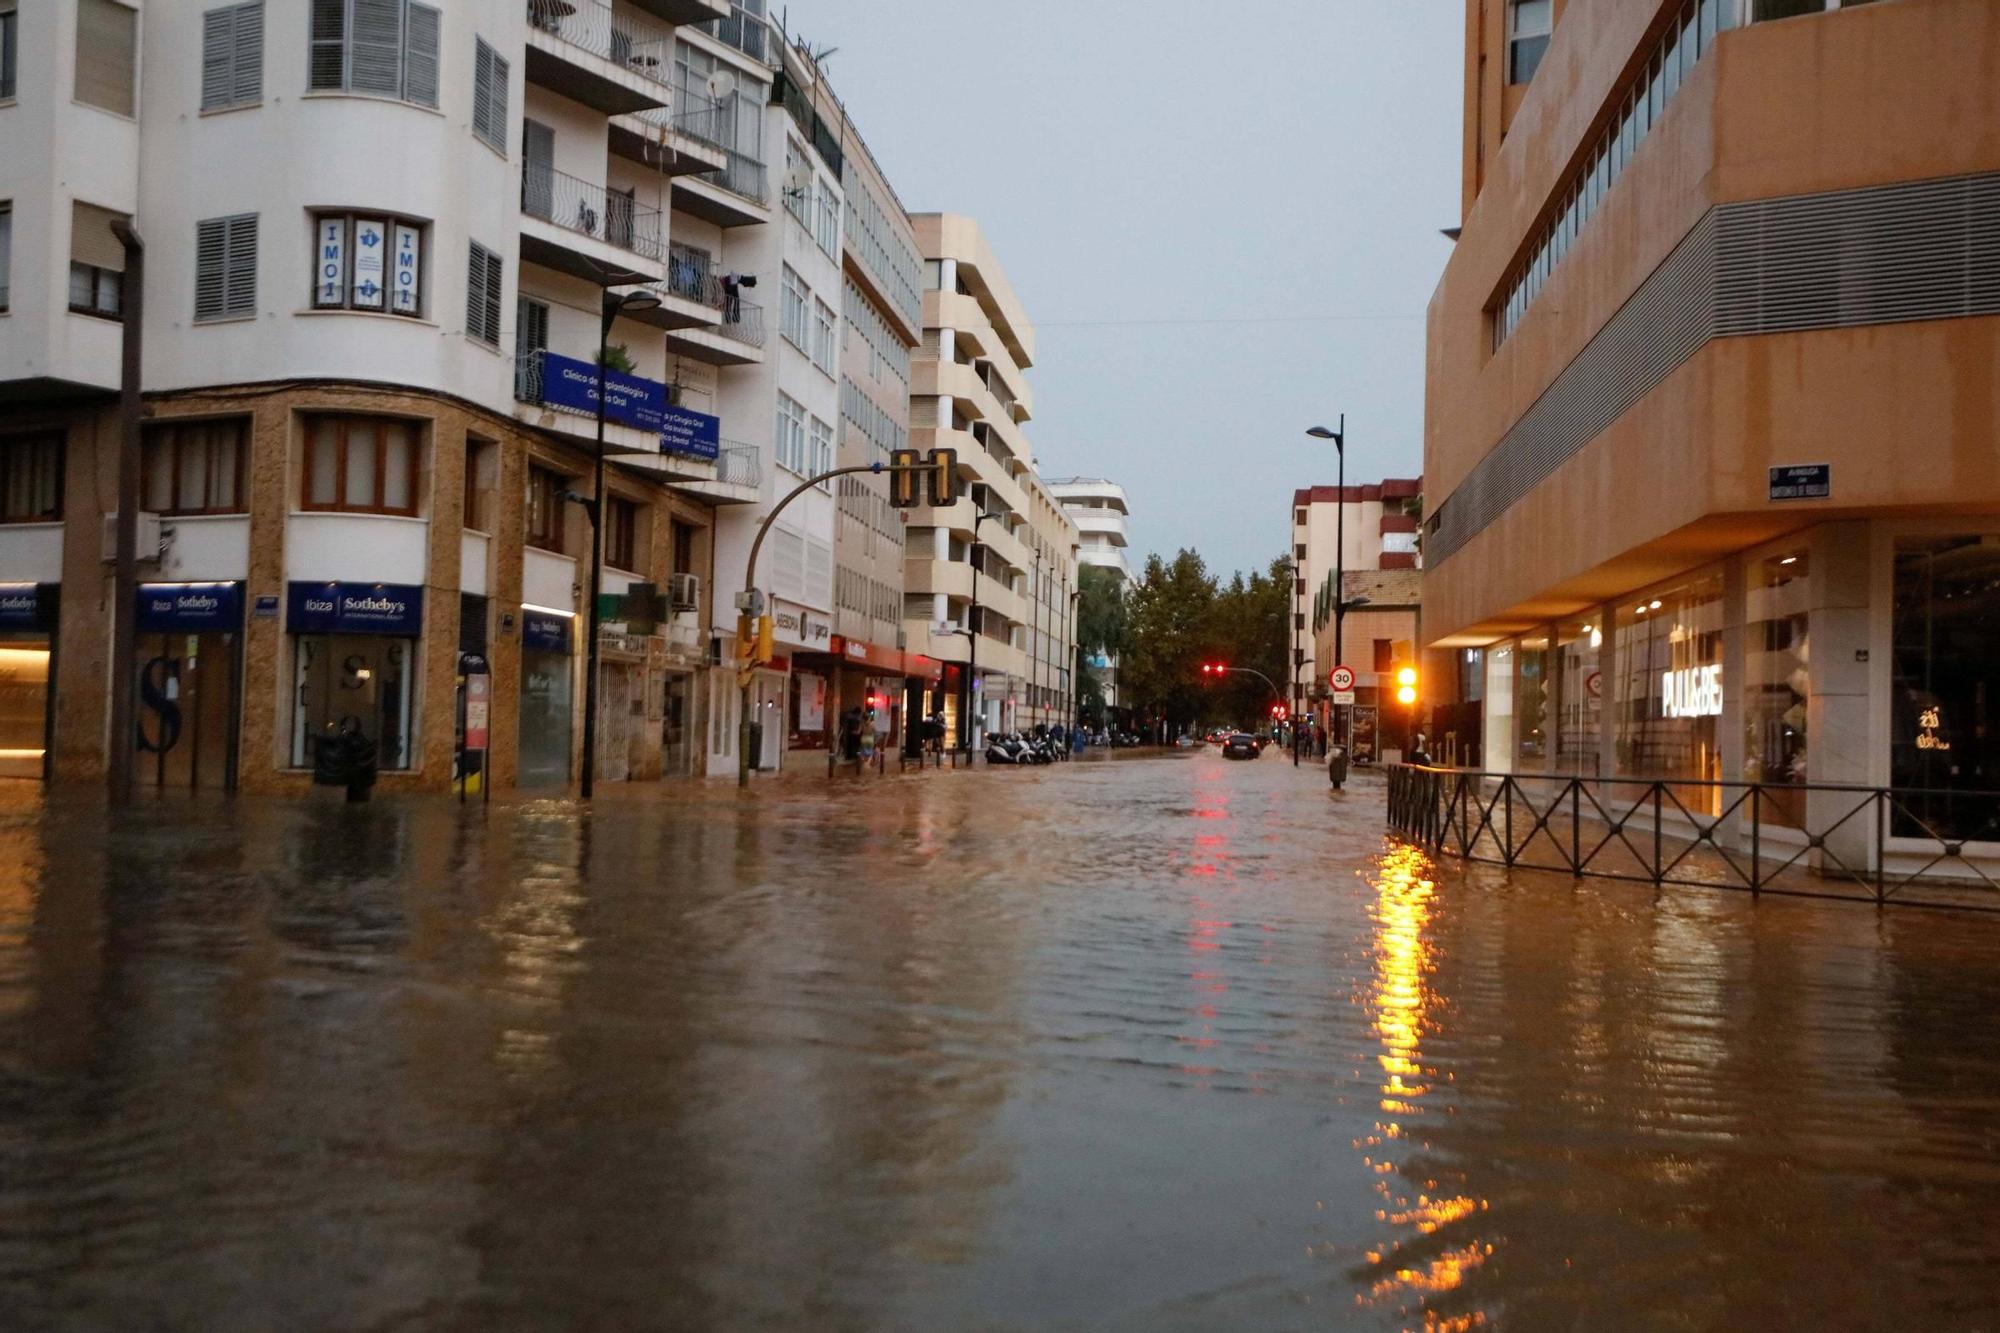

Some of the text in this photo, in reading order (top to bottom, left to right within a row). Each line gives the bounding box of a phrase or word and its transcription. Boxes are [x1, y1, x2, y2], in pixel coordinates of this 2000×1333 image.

[563, 368, 588, 384] Clínica
[589, 375, 599, 386] de
[604, 381, 644, 400] plantología
[587, 388, 628, 407] Ciruía Oral
[306, 597, 405, 614] Ibiza Sotheby's
[1335, 673, 1350, 683] 30
[1662, 664, 1723, 718] PULL&BE
